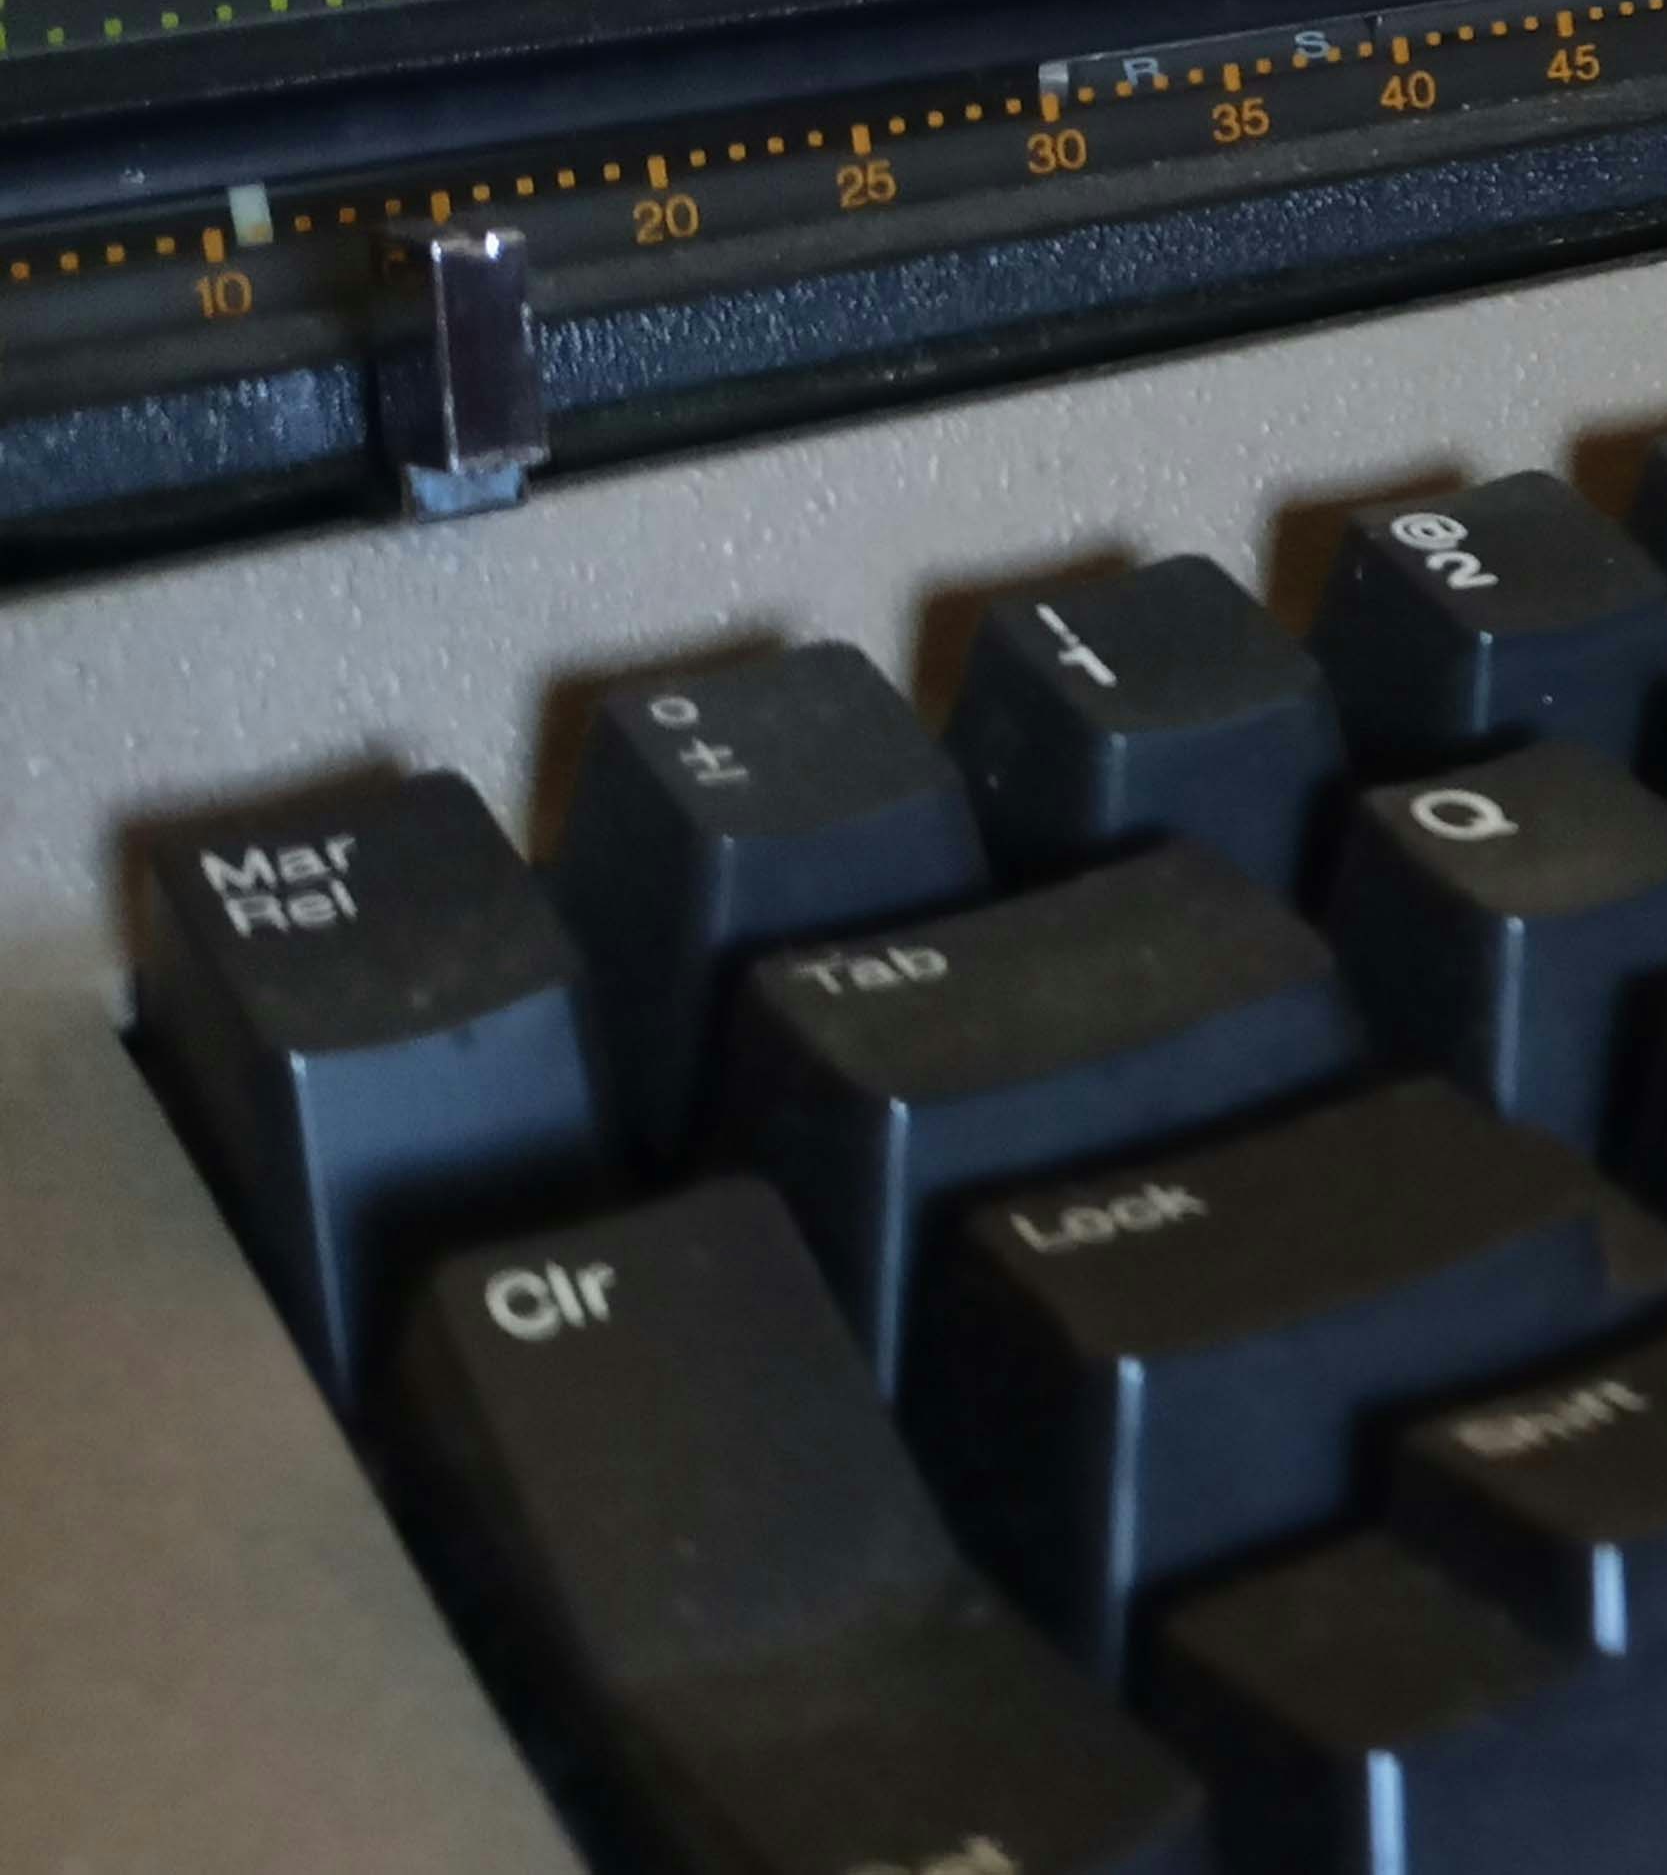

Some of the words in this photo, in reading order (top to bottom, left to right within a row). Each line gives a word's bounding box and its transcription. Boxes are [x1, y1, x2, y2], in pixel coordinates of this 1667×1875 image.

[1293, 30, 1335, 61] S
[197, 272, 252, 317] 10
[635, 195, 700, 243] 20
[838, 161, 897, 207] 25
[1030, 130, 1087, 174] 30
[1214, 98, 1270, 143] 35
[1381, 72, 1436, 110] 40
[1548, 44, 1600, 81] 45
[1390, 512, 1468, 550] @
[1425, 550, 1498, 589] 2
[1058, 644, 1118, 687] 1
[1412, 790, 1516, 839] Q
[201, 833, 357, 893] Mar
[223, 877, 358, 939] Rel
[799, 948, 947, 993] Tab
[1012, 1185, 1201, 1250] Lock
[485, 1257, 618, 1343] Clr
